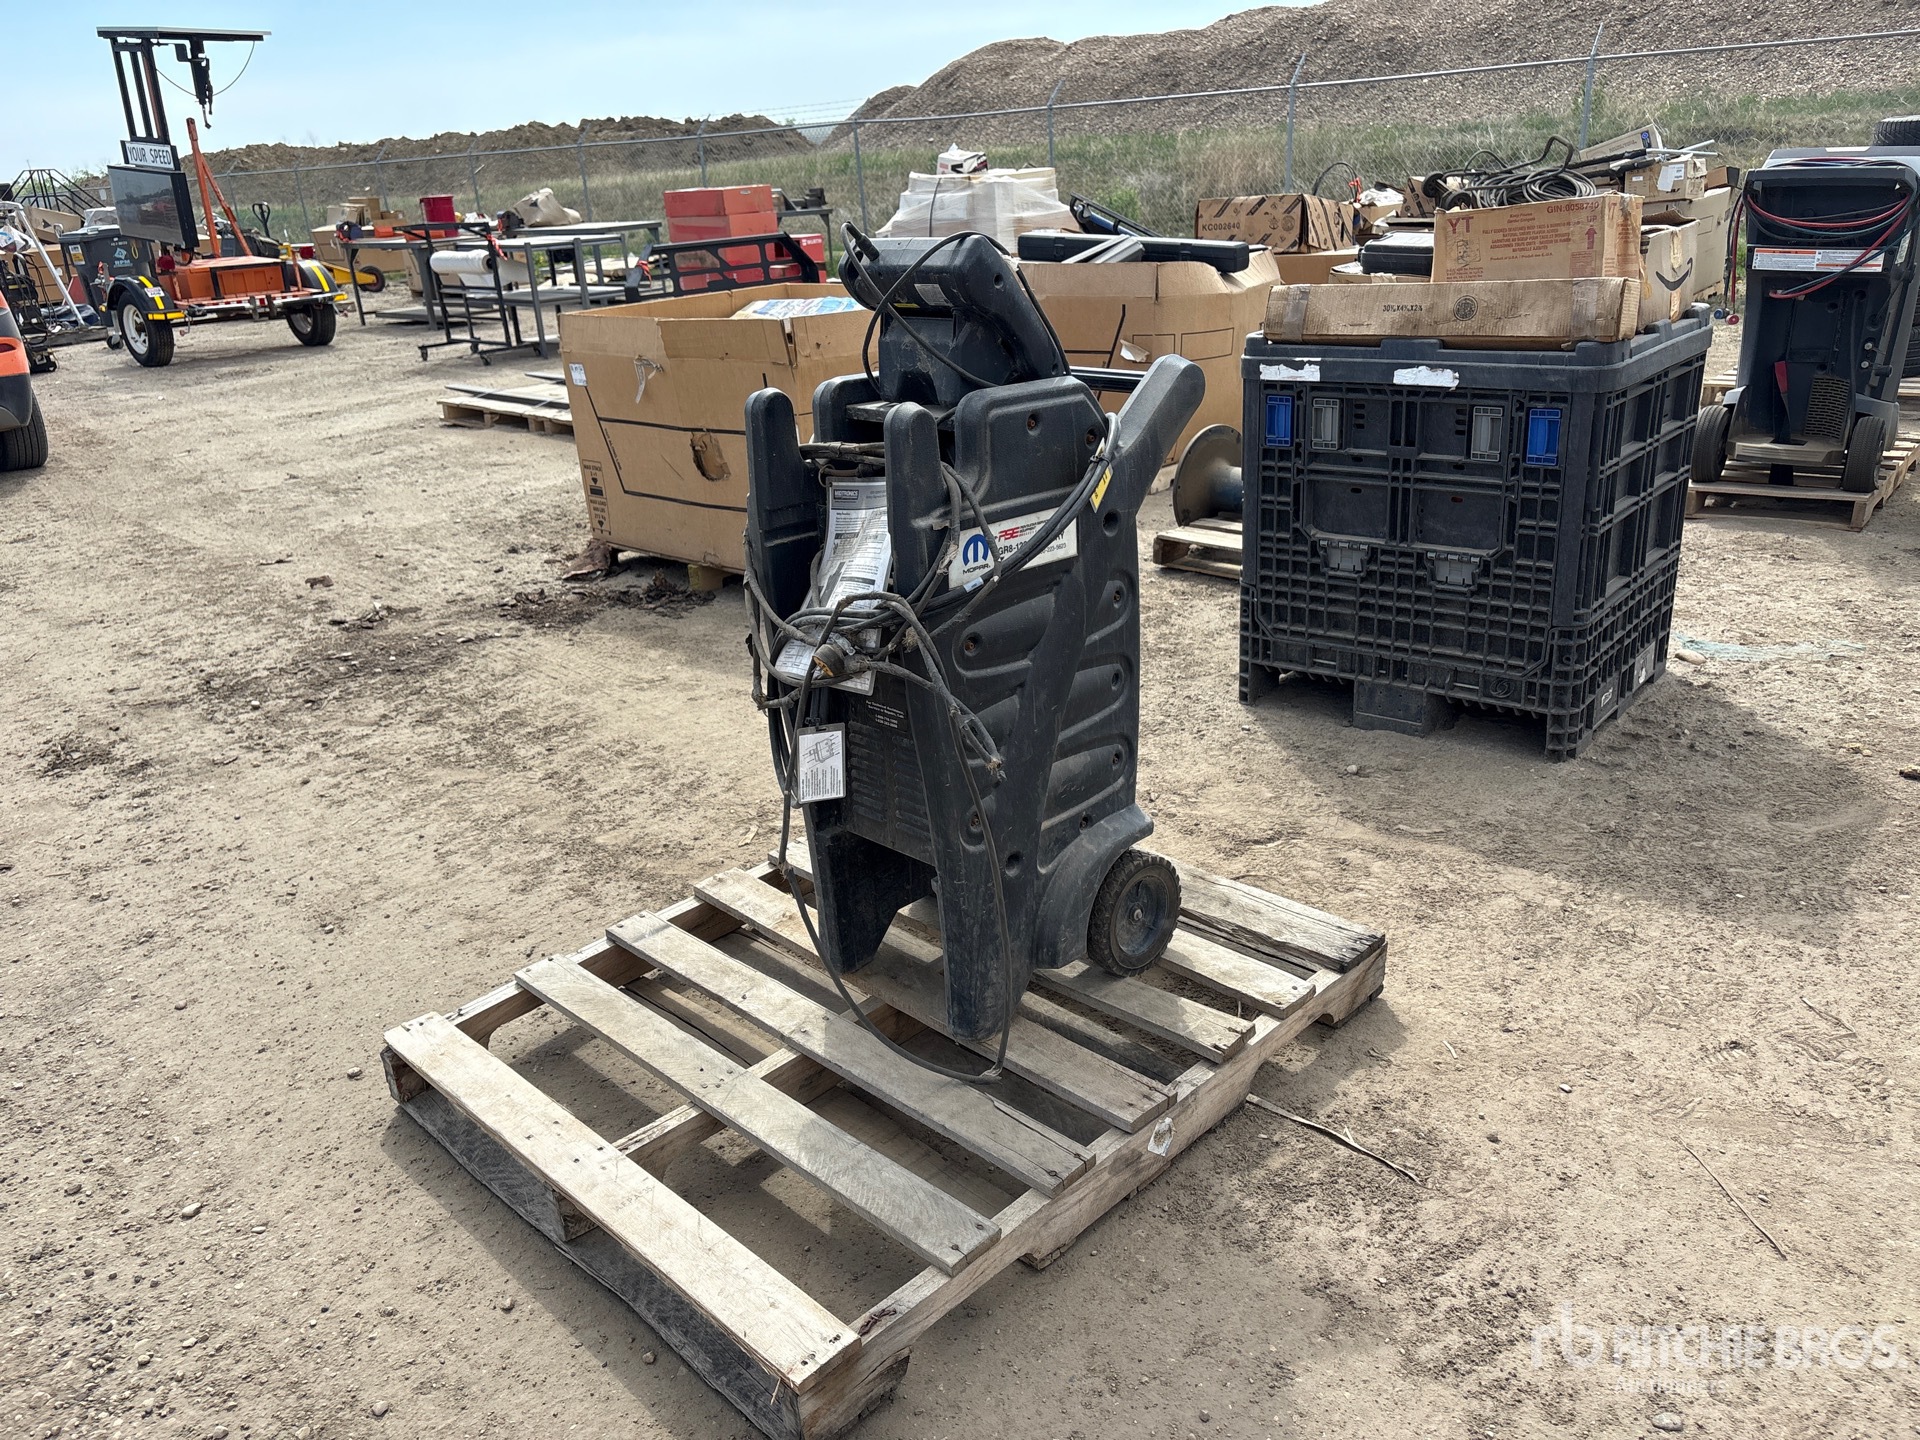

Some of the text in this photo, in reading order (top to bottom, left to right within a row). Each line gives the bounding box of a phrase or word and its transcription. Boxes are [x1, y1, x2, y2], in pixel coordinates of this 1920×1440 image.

[128, 146, 171, 165] YOUR SPEED
[1447, 216, 1474, 234] YT
